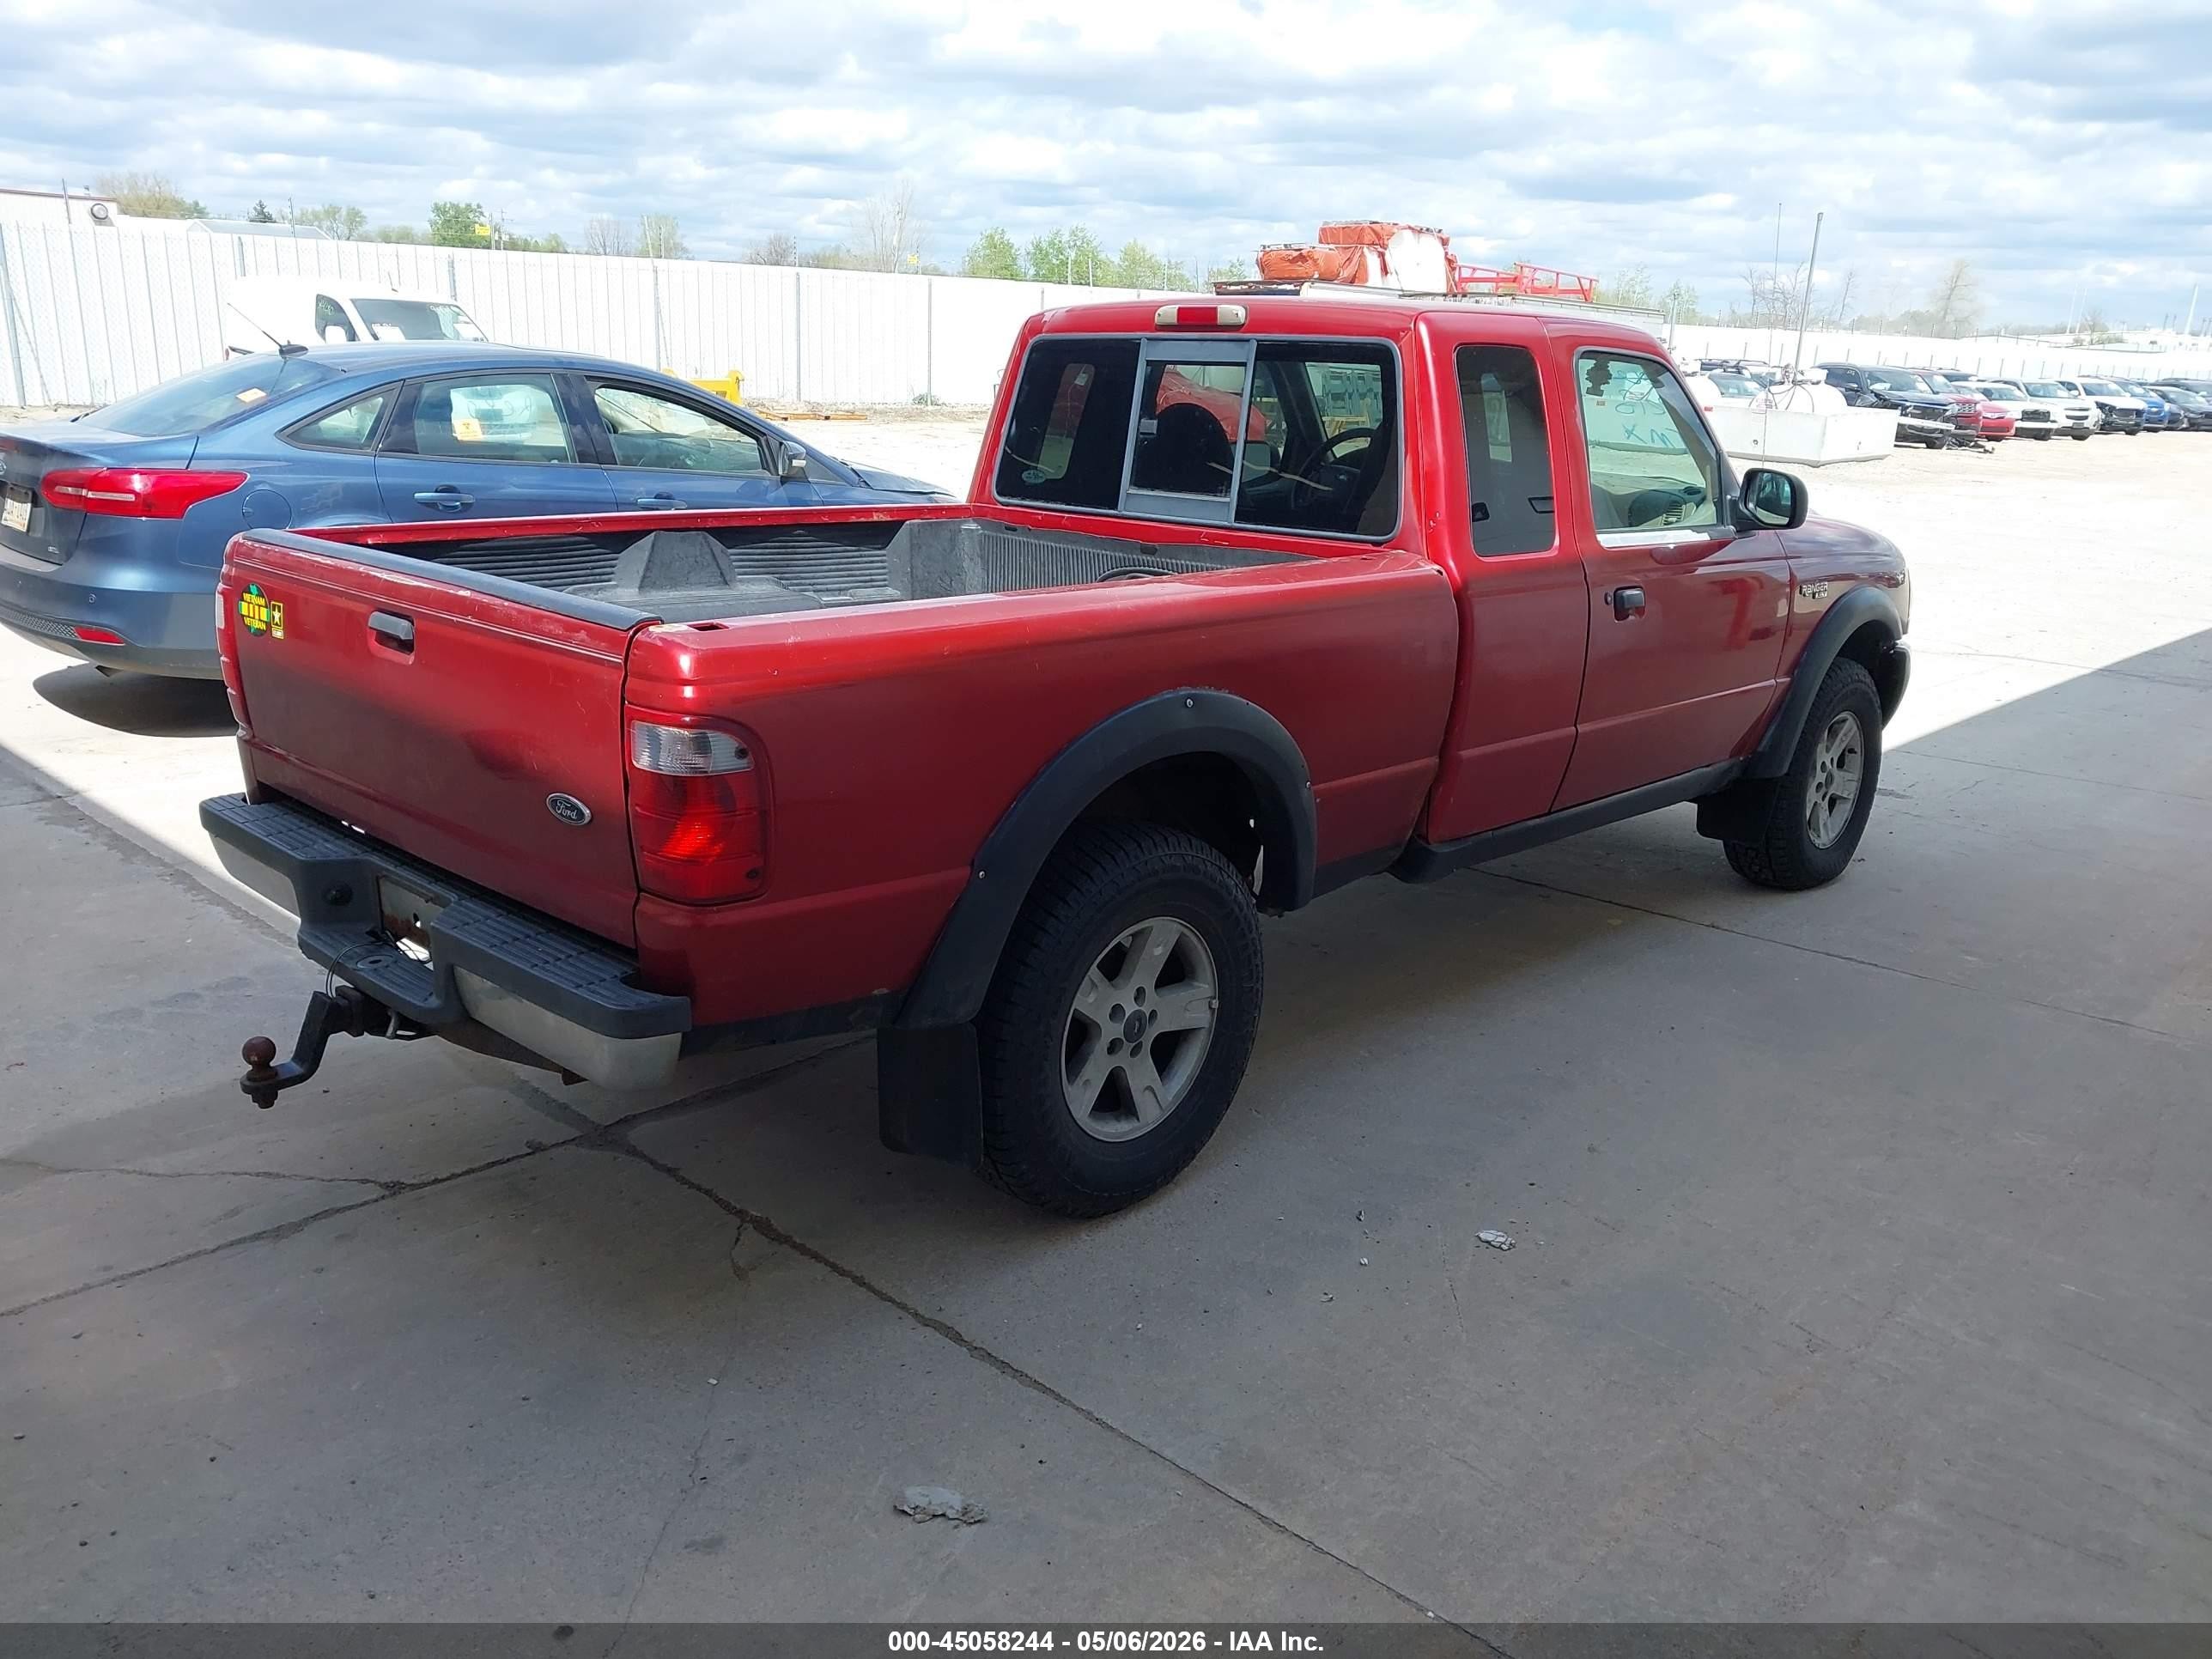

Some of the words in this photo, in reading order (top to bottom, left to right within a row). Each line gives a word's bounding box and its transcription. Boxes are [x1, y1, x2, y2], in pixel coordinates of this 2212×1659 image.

[243, 593, 265, 606] VIETNAM
[245, 617, 266, 631] VETERAN
[556, 800, 578, 819] Ford
